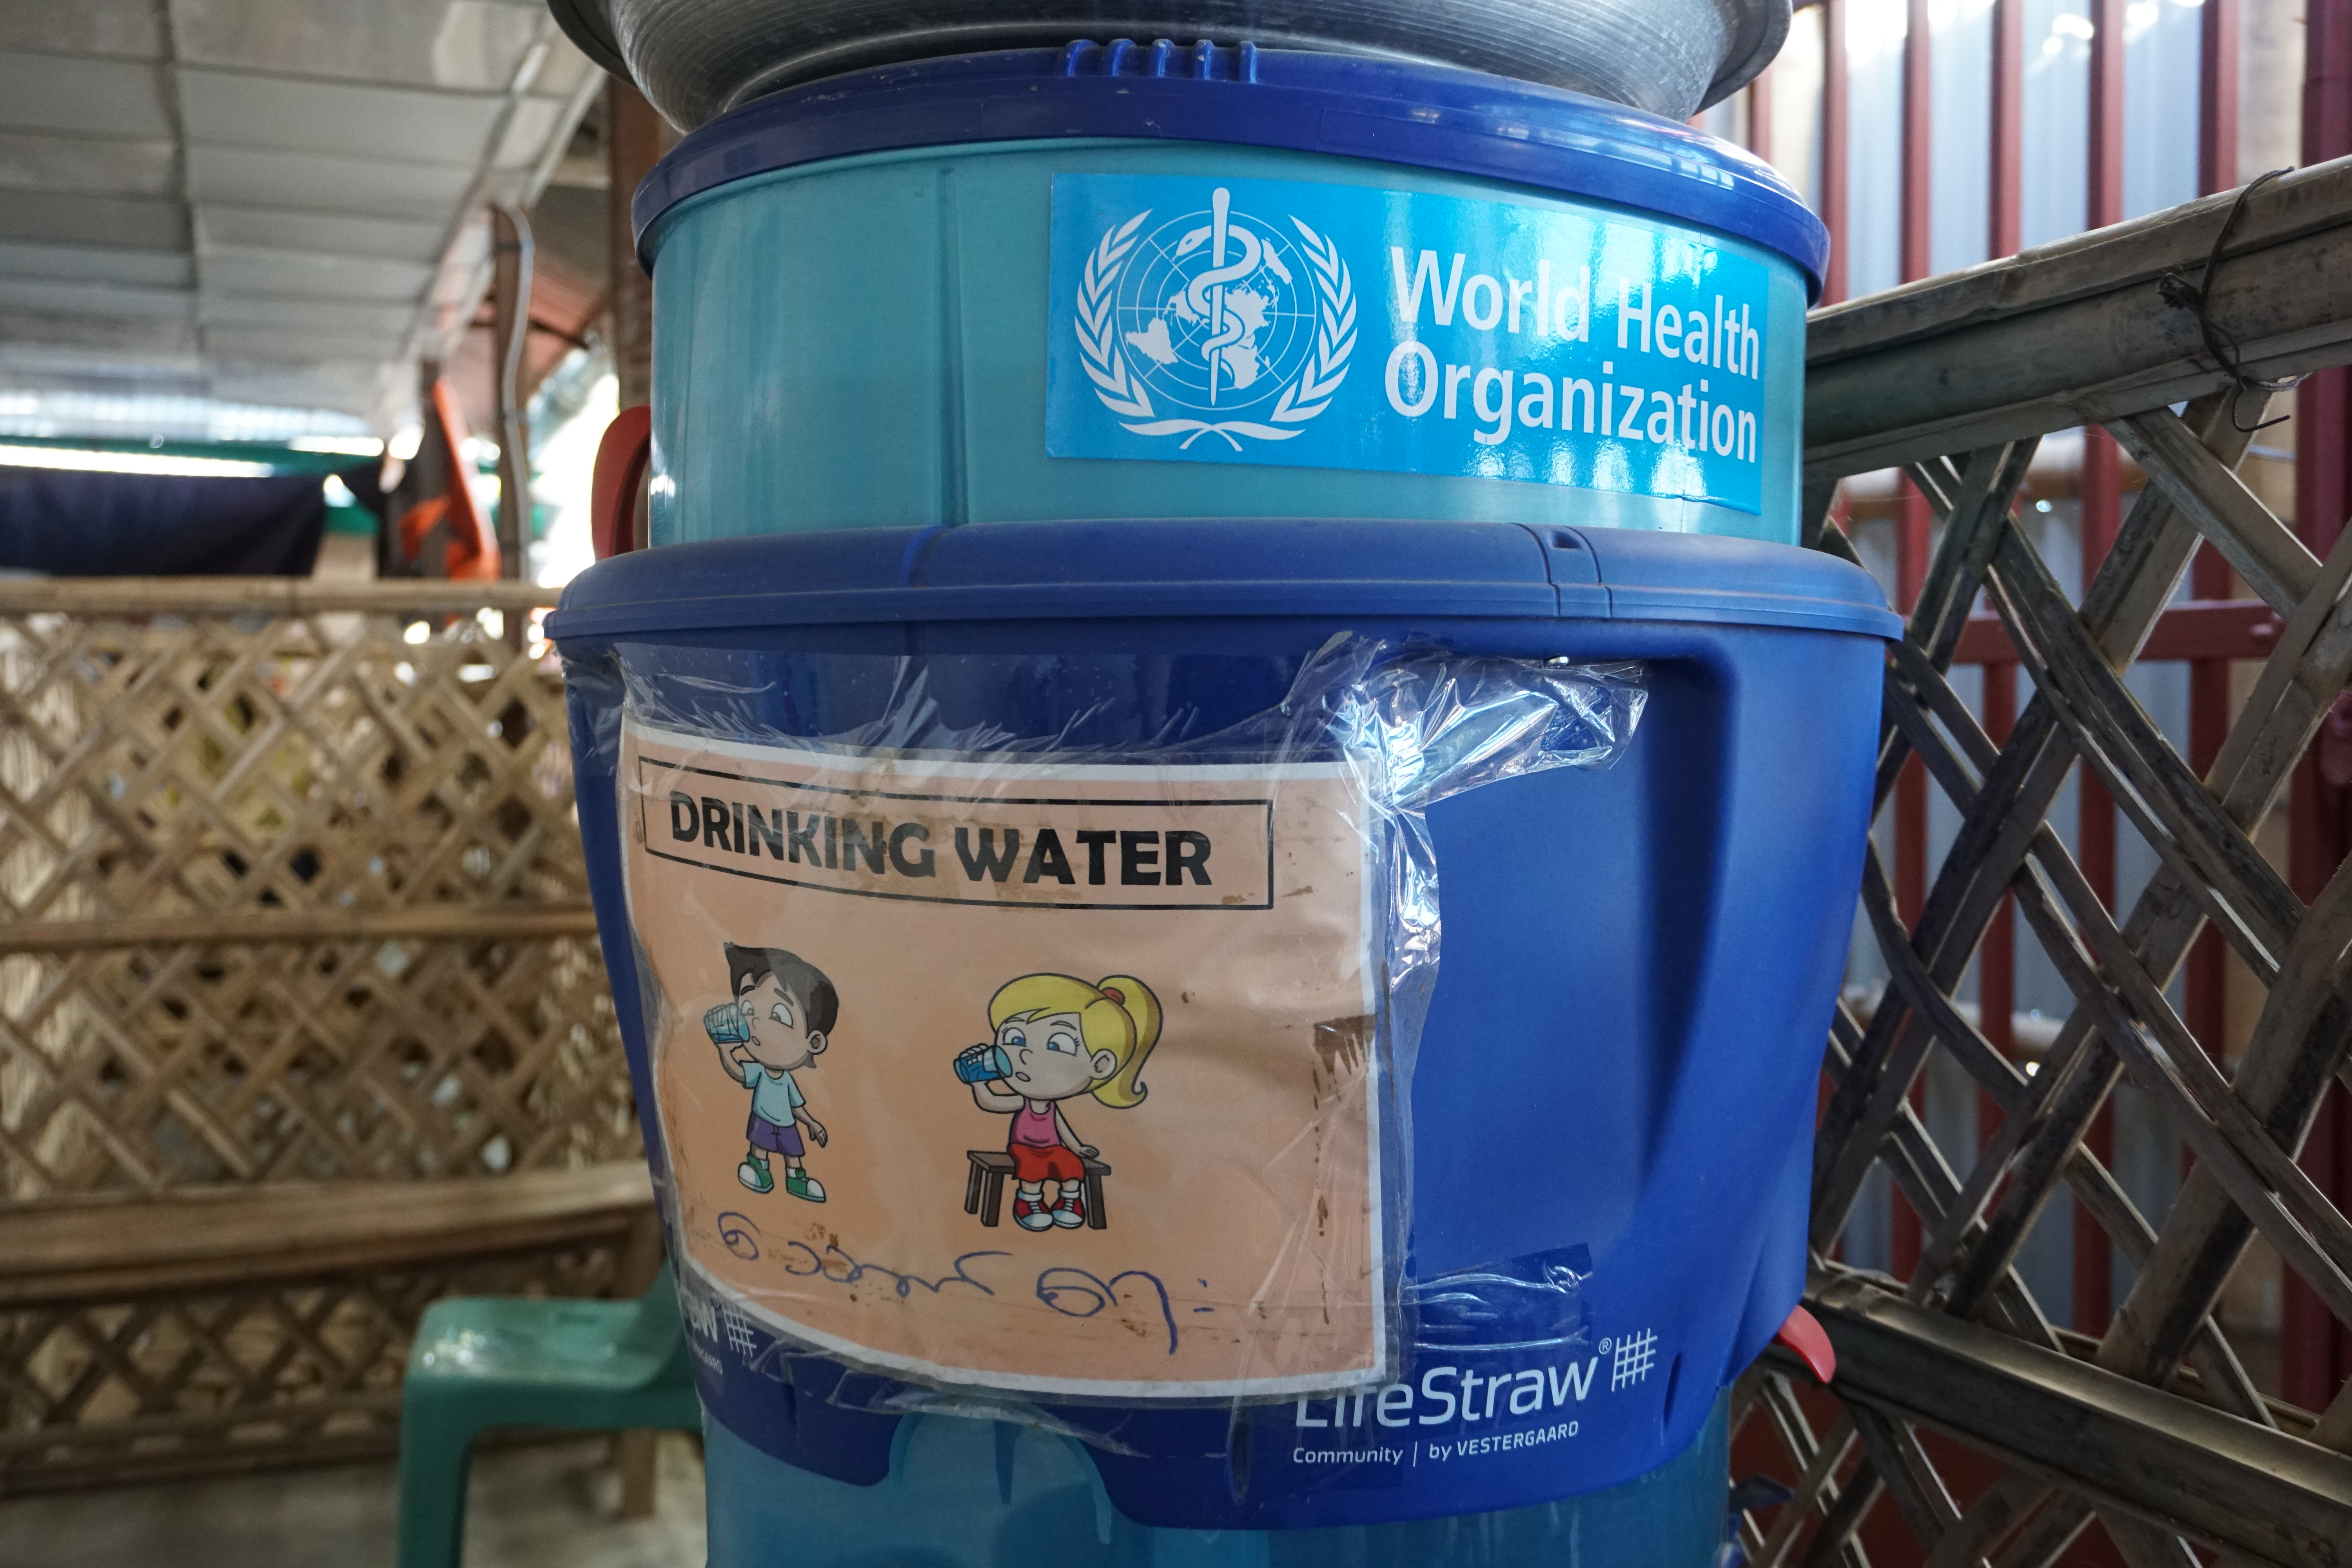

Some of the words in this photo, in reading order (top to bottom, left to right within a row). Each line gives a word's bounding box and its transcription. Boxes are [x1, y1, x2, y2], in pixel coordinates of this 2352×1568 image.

[1390, 246, 1590, 343] World
[1617, 277, 1759, 380] Health
[1385, 340, 1756, 463] Organization
[669, 790, 936, 878] DRINKING
[954, 826, 1212, 886] WATER
[1293, 1447, 1403, 1466] Community
[1429, 1443, 1452, 1462] by
[1457, 1420, 1579, 1456] VESTERGAARD
